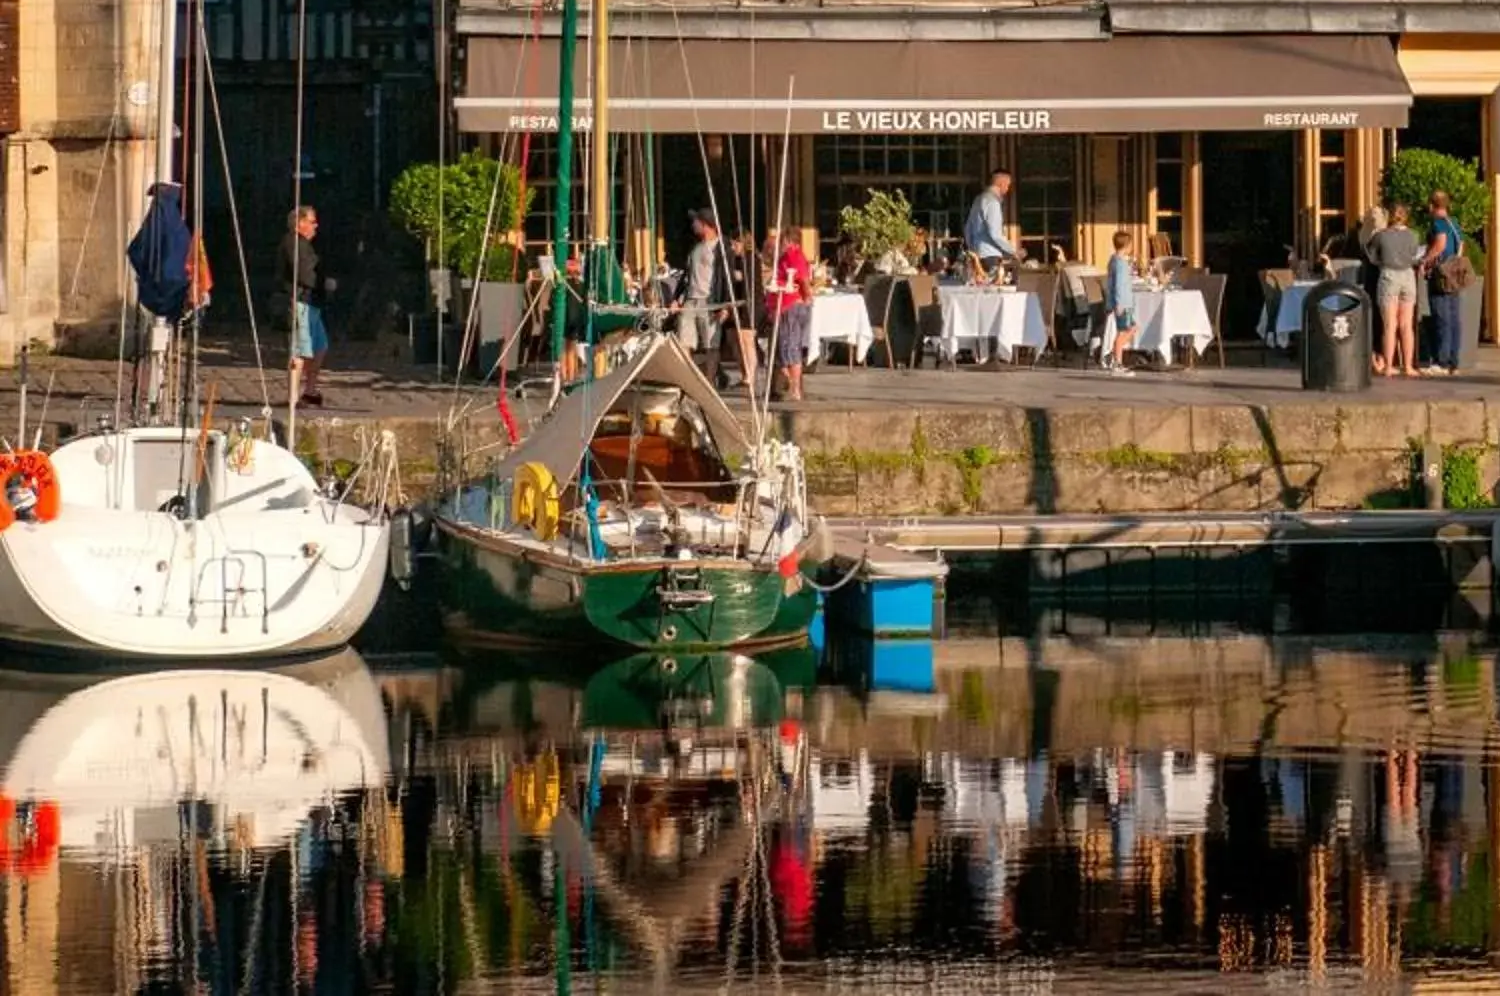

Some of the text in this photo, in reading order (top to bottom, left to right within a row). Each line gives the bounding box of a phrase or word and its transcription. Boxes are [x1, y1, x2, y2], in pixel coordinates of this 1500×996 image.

[823, 111, 1050, 129] LE VIEUX HONFLEUR
[1263, 112, 1359, 125] RESTAURANT
